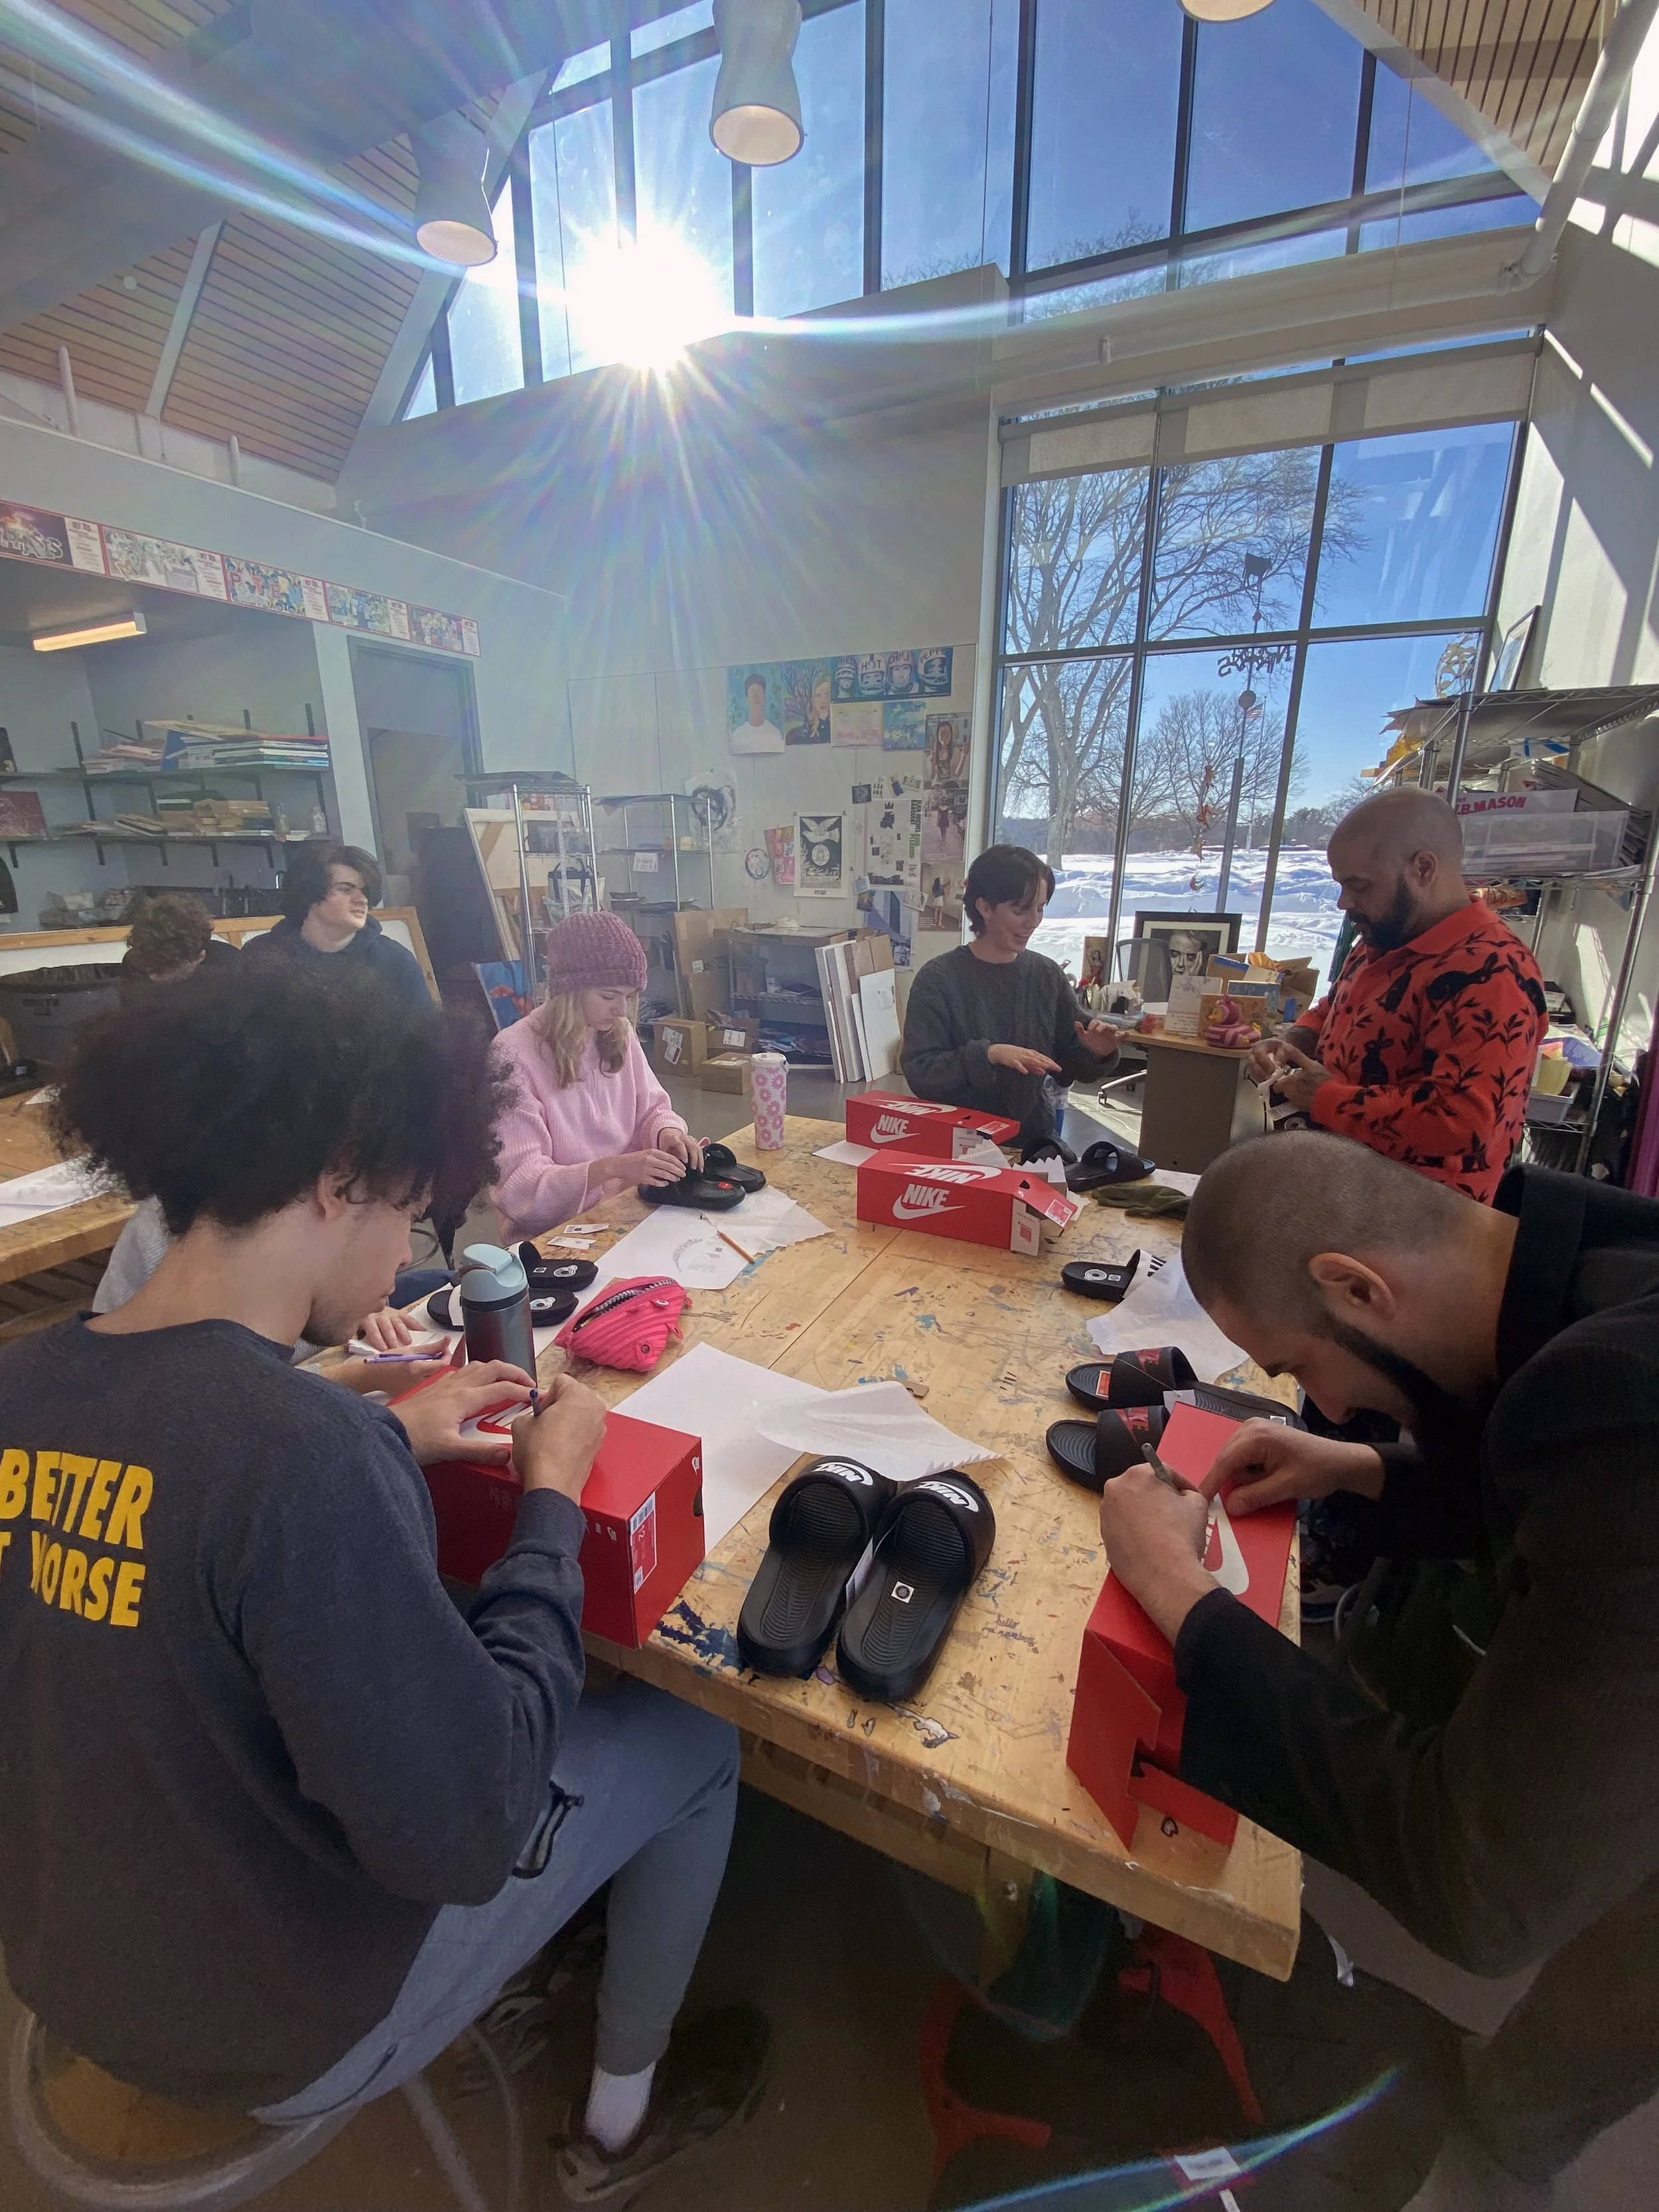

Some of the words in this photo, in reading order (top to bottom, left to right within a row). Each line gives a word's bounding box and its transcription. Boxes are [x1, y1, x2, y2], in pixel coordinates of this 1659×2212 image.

[861, 659, 882, 672] HOT
[879, 1102, 938, 1116] NIKE
[878, 1114, 909, 1134] NIKE
[904, 1165, 982, 1184] NIKE
[902, 1184, 950, 1208] NIKE
[0, 1449, 154, 1550] BETTER
[995, 1613, 1020, 1629] hello
